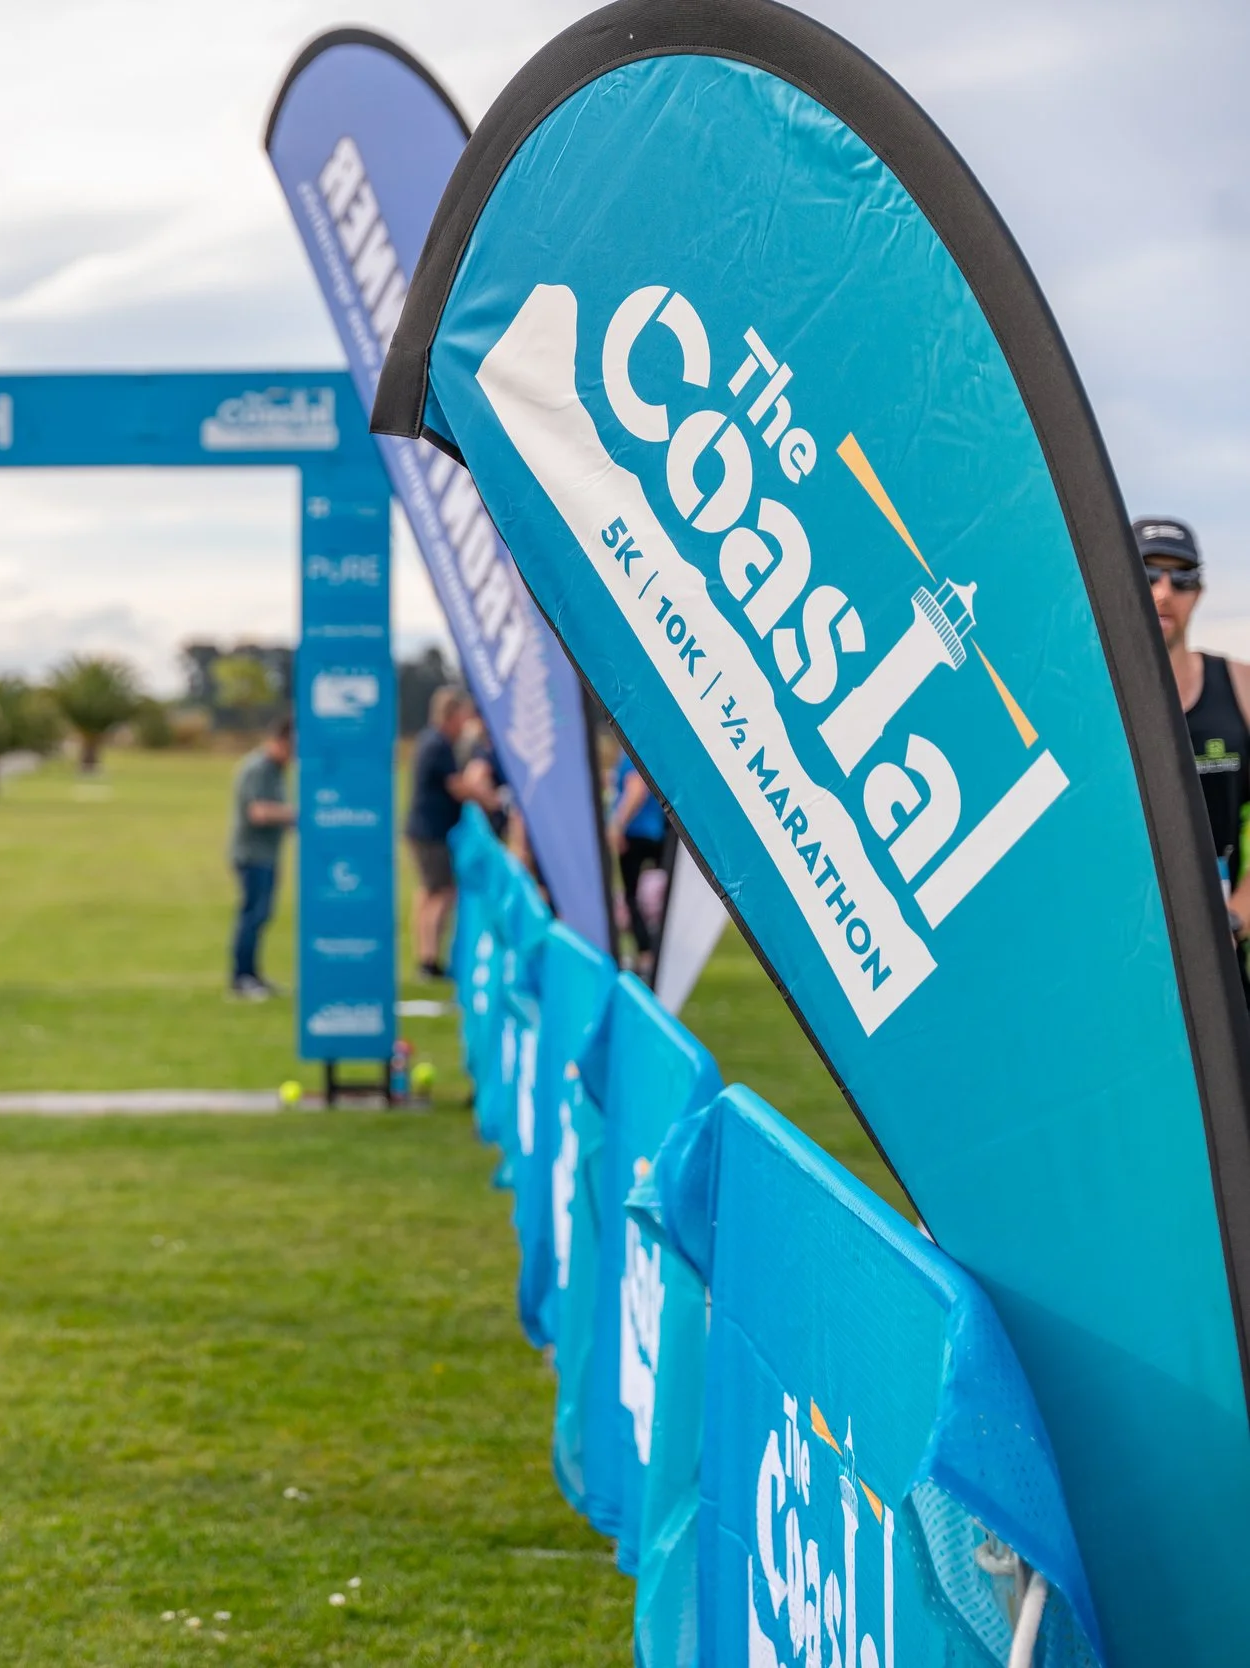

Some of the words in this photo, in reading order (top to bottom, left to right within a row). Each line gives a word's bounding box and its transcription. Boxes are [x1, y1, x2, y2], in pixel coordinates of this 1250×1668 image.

[727, 325, 817, 495] The
[601, 516, 644, 577] 5K
[654, 596, 707, 677] 10K
[746, 746, 892, 992] MARATHON
[602, 285, 1070, 930] Coastal
[783, 1391, 812, 1507] The
